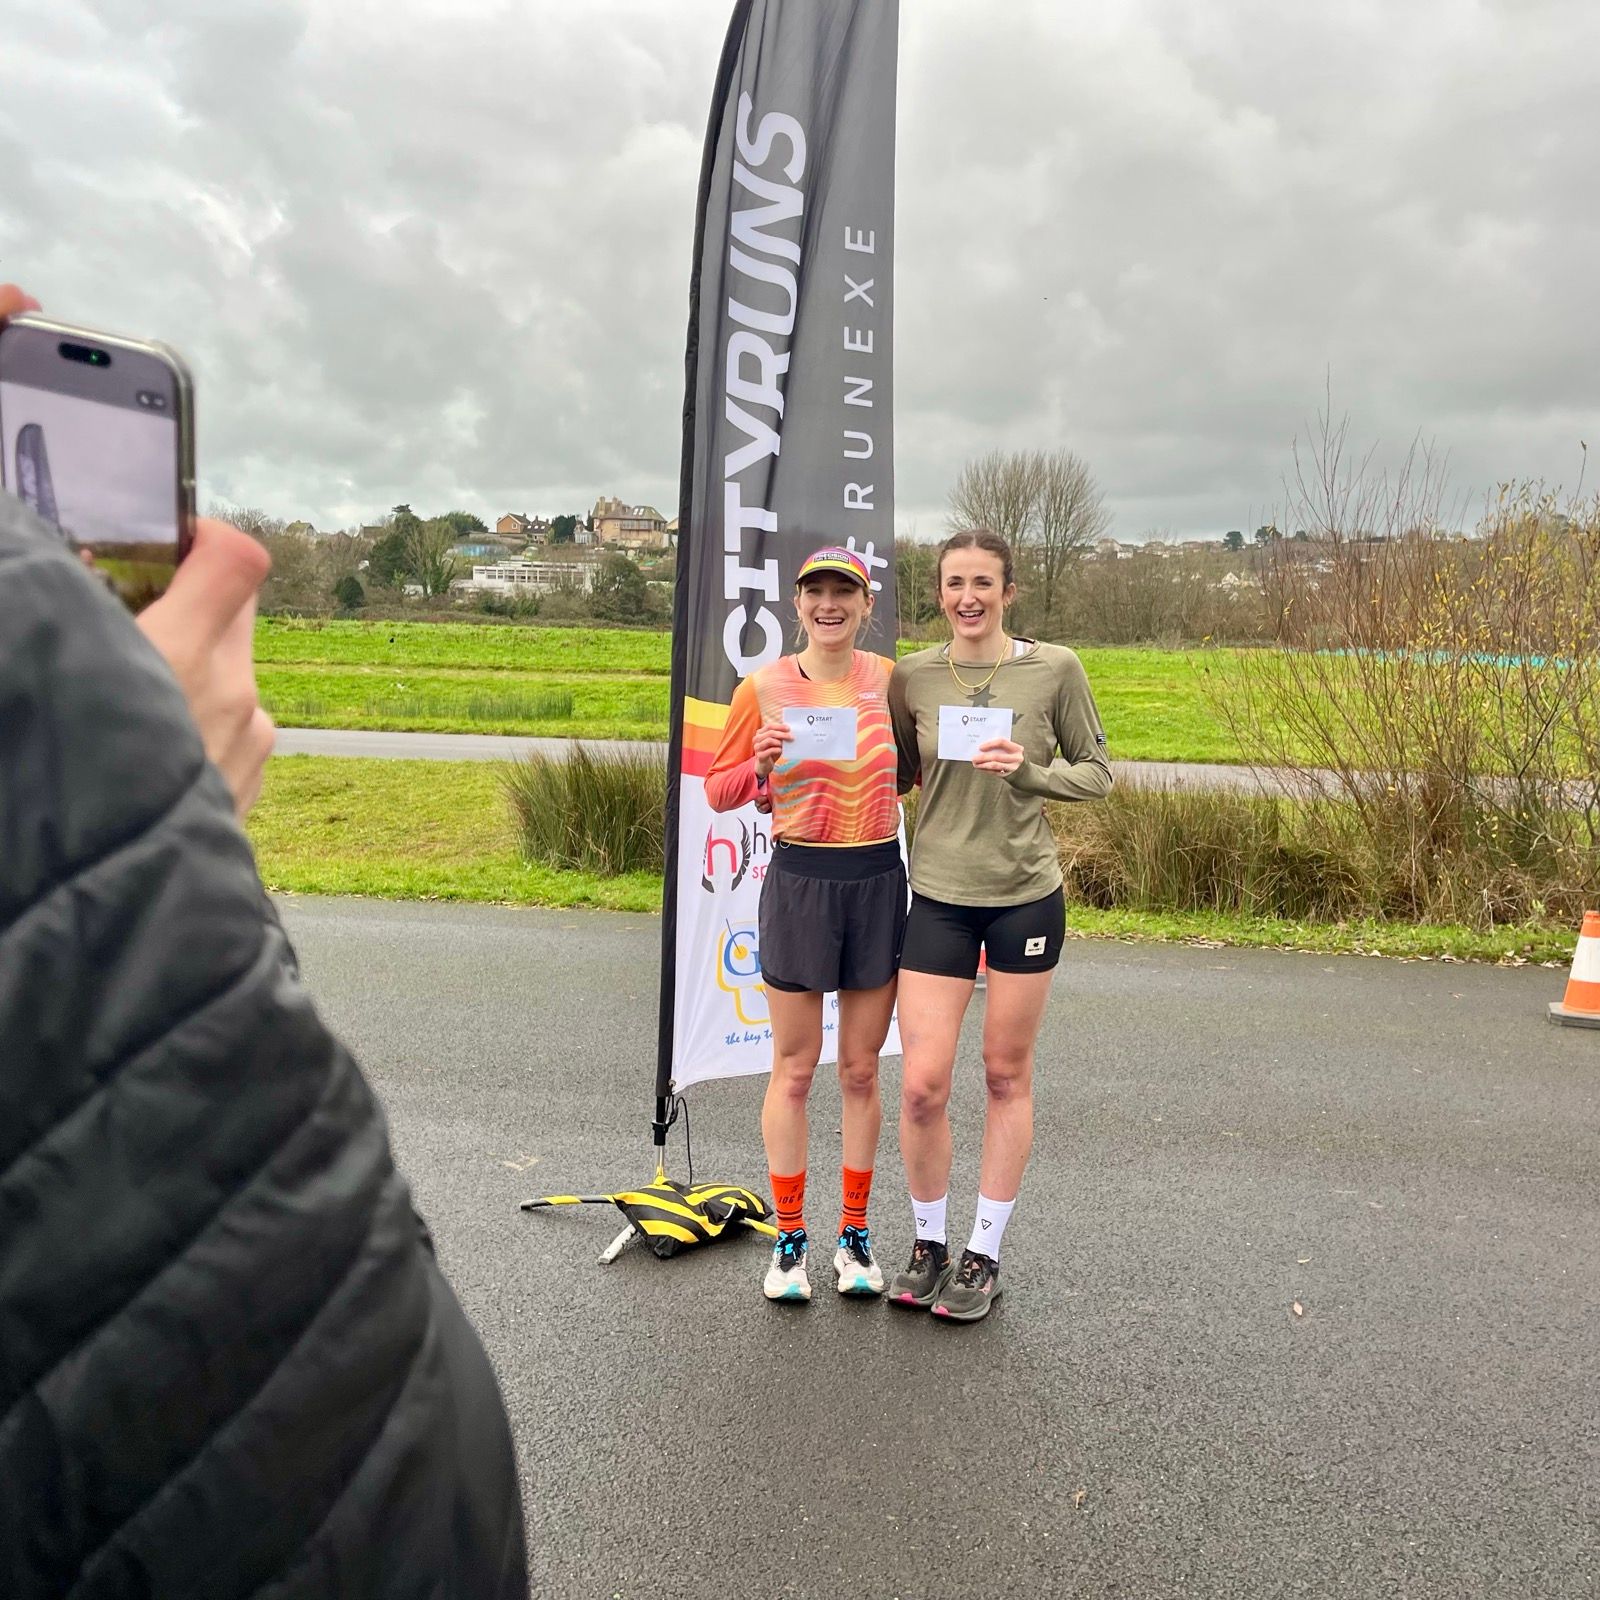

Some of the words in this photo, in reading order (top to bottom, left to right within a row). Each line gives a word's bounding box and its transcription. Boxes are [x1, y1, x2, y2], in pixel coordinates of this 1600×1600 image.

[722, 90, 807, 678] CITYRUNS
[725, 1032, 740, 1045] the
[743, 1031, 761, 1045] key
